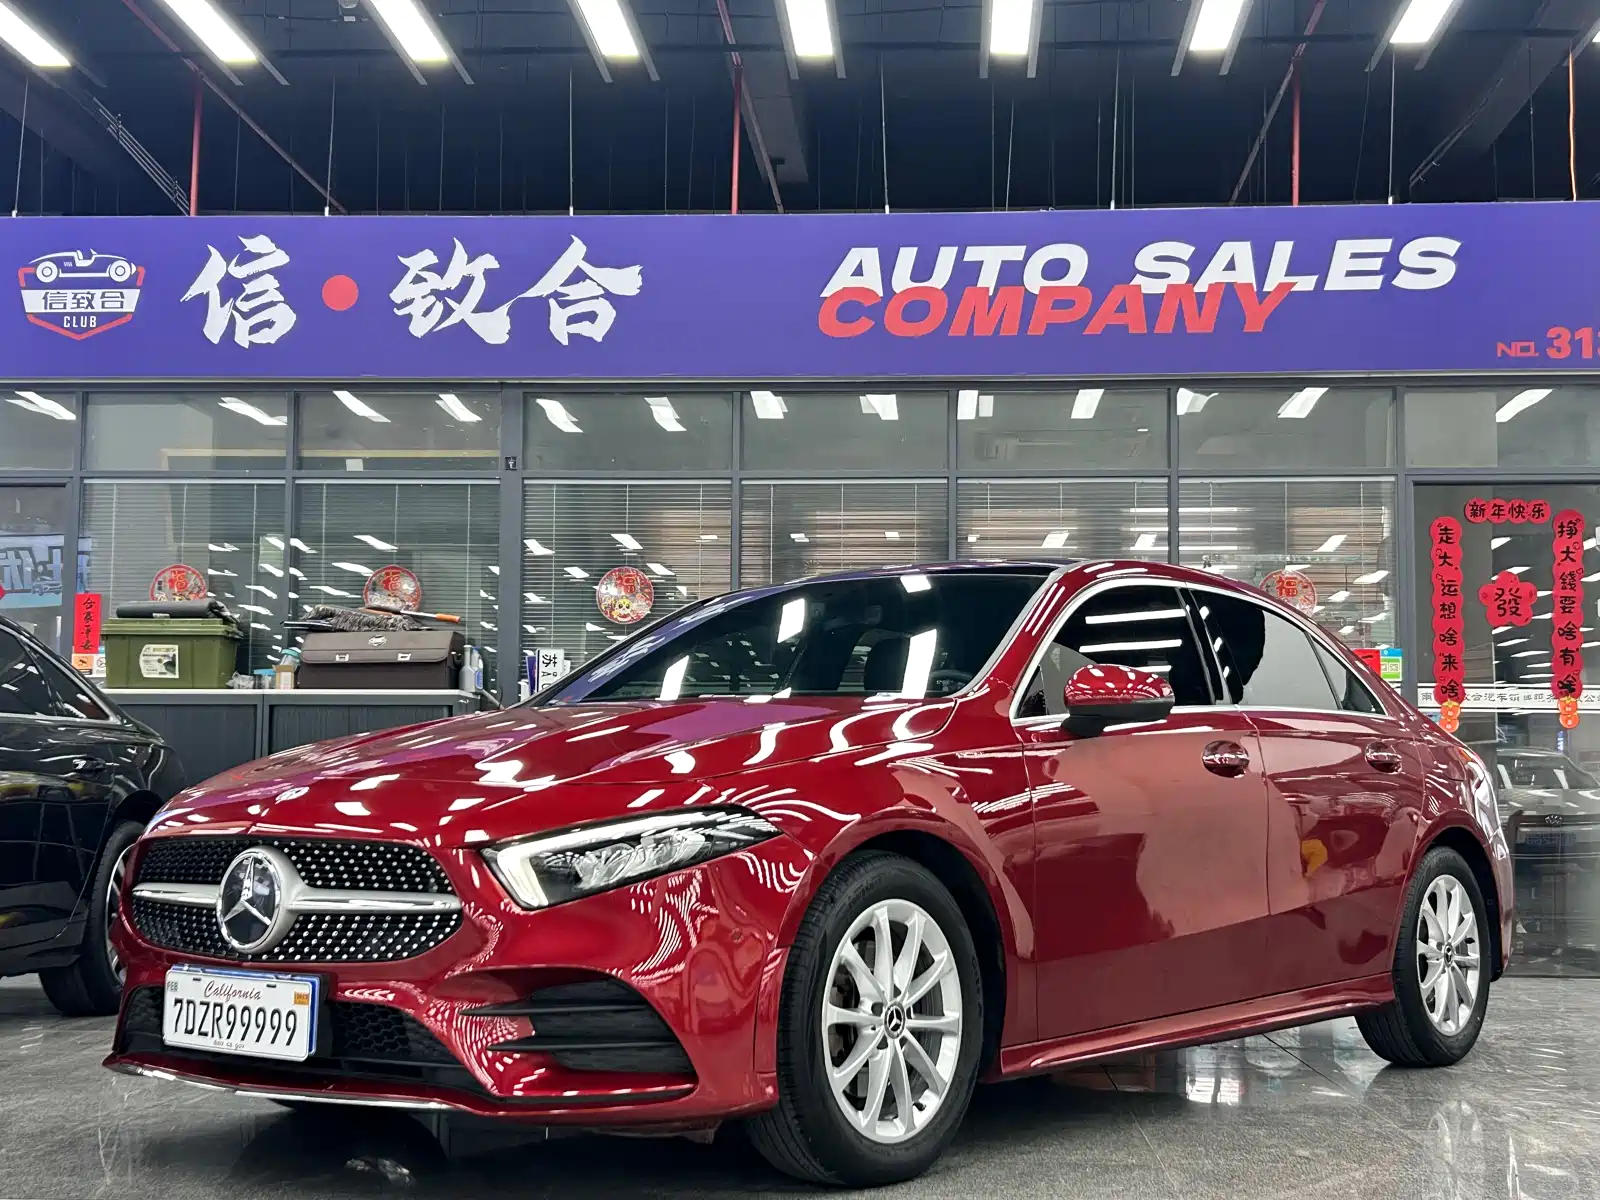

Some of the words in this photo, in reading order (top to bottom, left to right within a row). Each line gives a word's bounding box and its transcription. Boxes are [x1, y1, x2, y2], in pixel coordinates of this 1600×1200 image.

[820, 243, 1089, 297] AUTO
[1128, 236, 1463, 295] SALES
[42, 290, 126, 311] 信致合
[818, 281, 1299, 338] COMPANY
[63, 315, 98, 328] CLUB
[1545, 326, 1600, 359] 31
[1469, 501, 1546, 520] 新年快乐
[1276, 576, 1299, 598] 福
[1494, 587, 1523, 618] 發
[1437, 526, 1460, 699] 走大运想啥来啥
[204, 980, 262, 1003] California
[173, 997, 298, 1047] 7DZR99999
